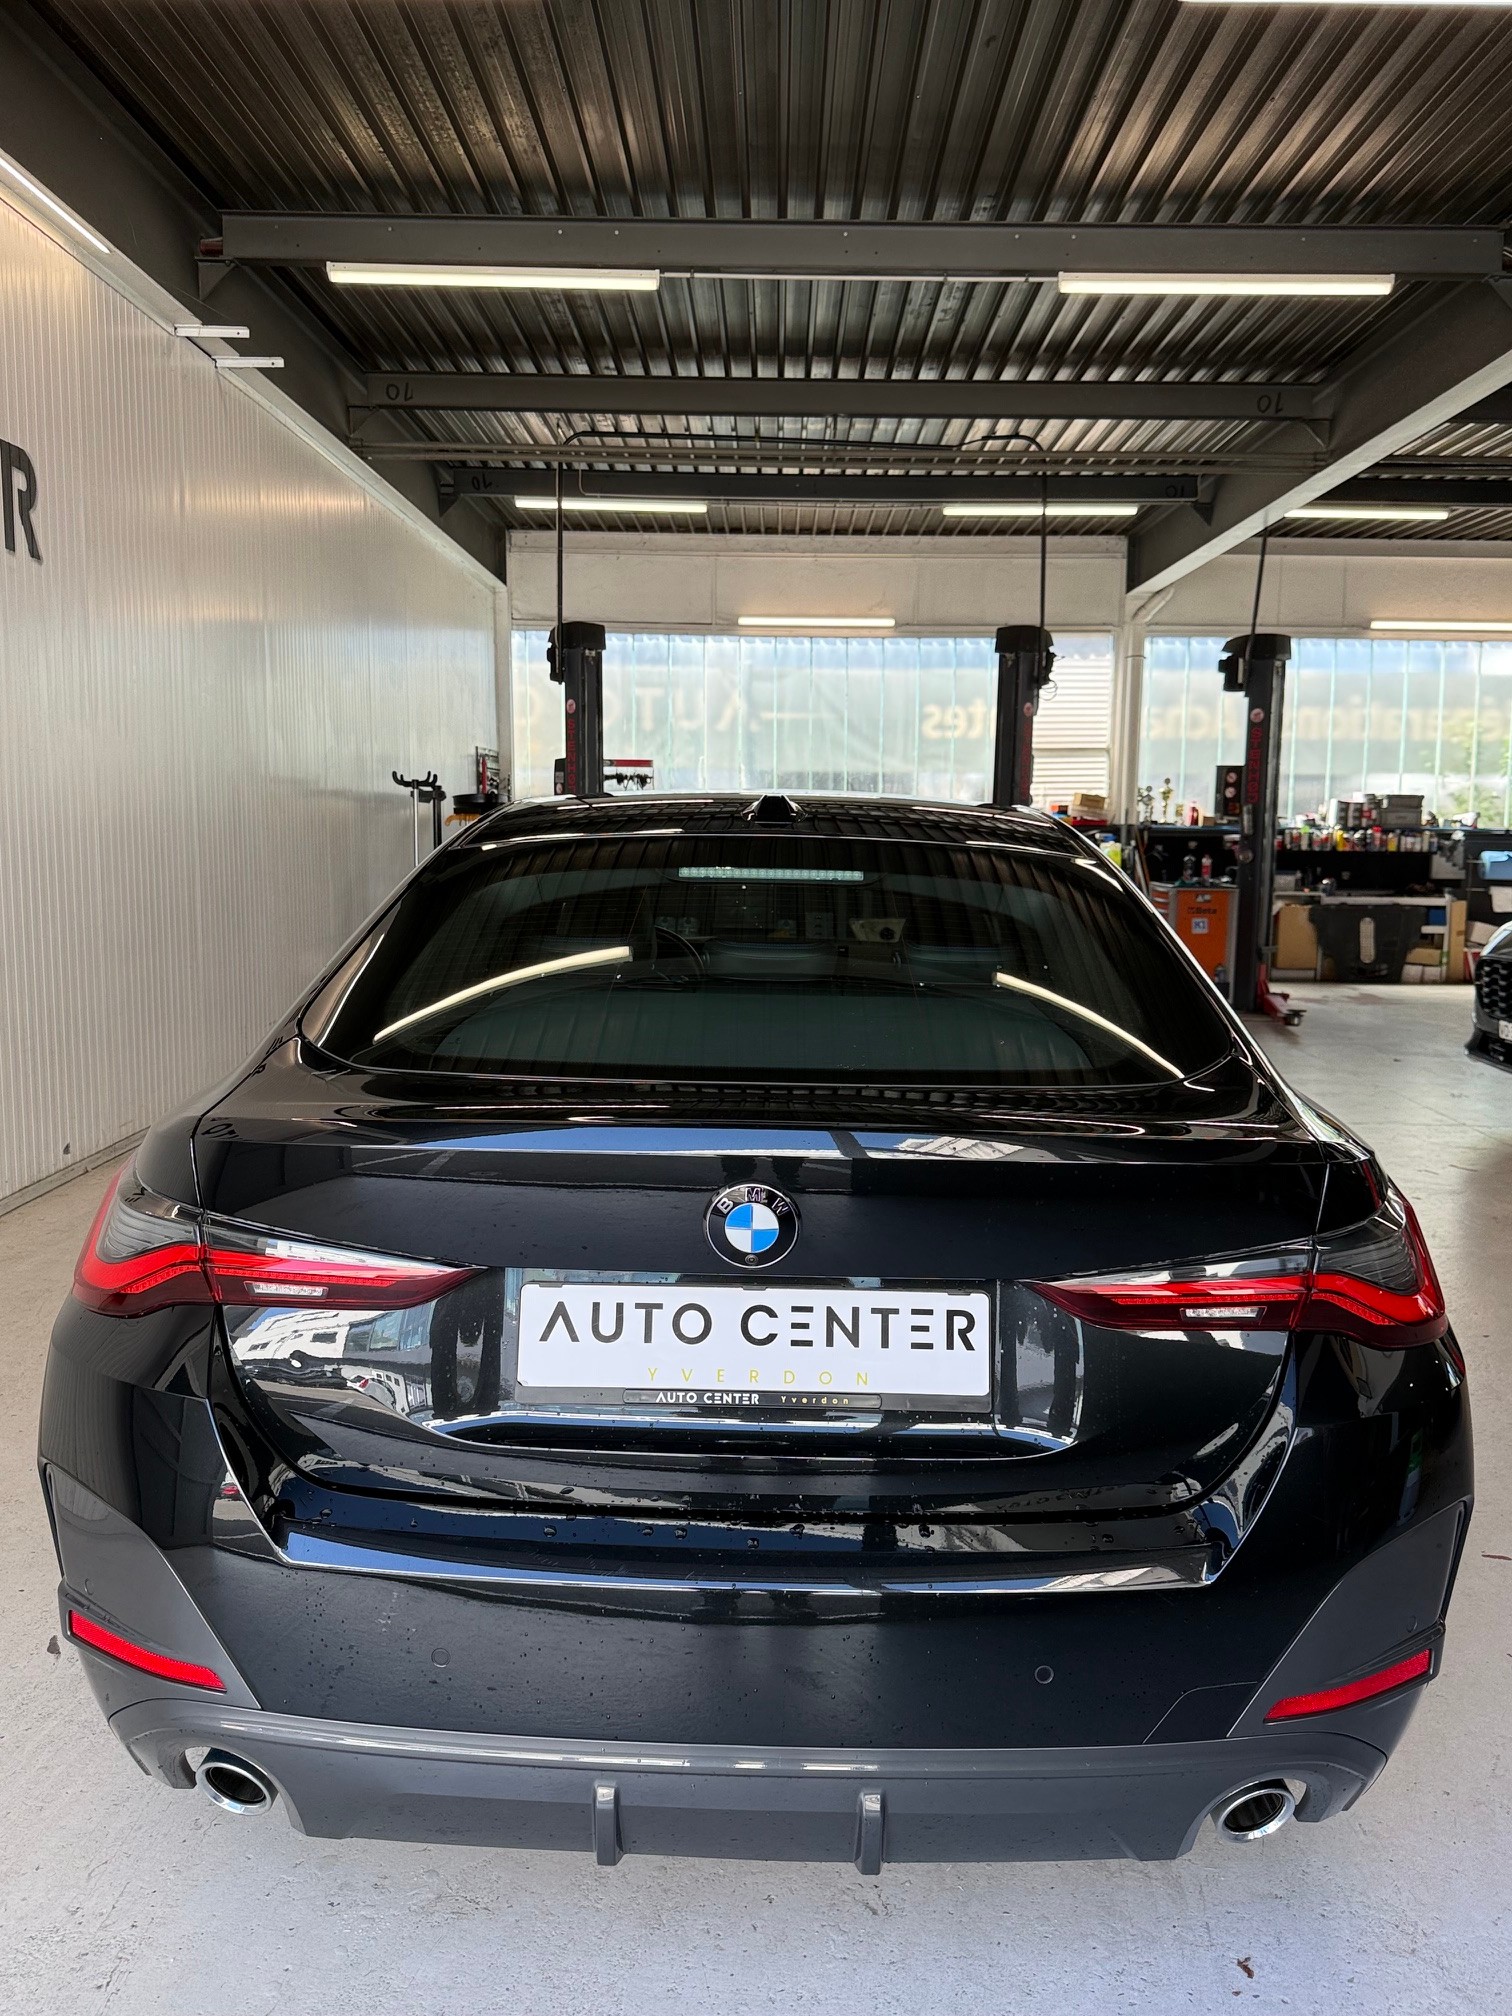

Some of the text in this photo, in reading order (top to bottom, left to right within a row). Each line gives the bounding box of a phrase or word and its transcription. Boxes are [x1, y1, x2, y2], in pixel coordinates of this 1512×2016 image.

[716, 1187, 789, 1216] BMW
[539, 1301, 976, 1351] AUTO CENTER
[647, 1367, 869, 1386] YVERDON
[655, 1391, 849, 1405] AUTO CENTER Yverdon
